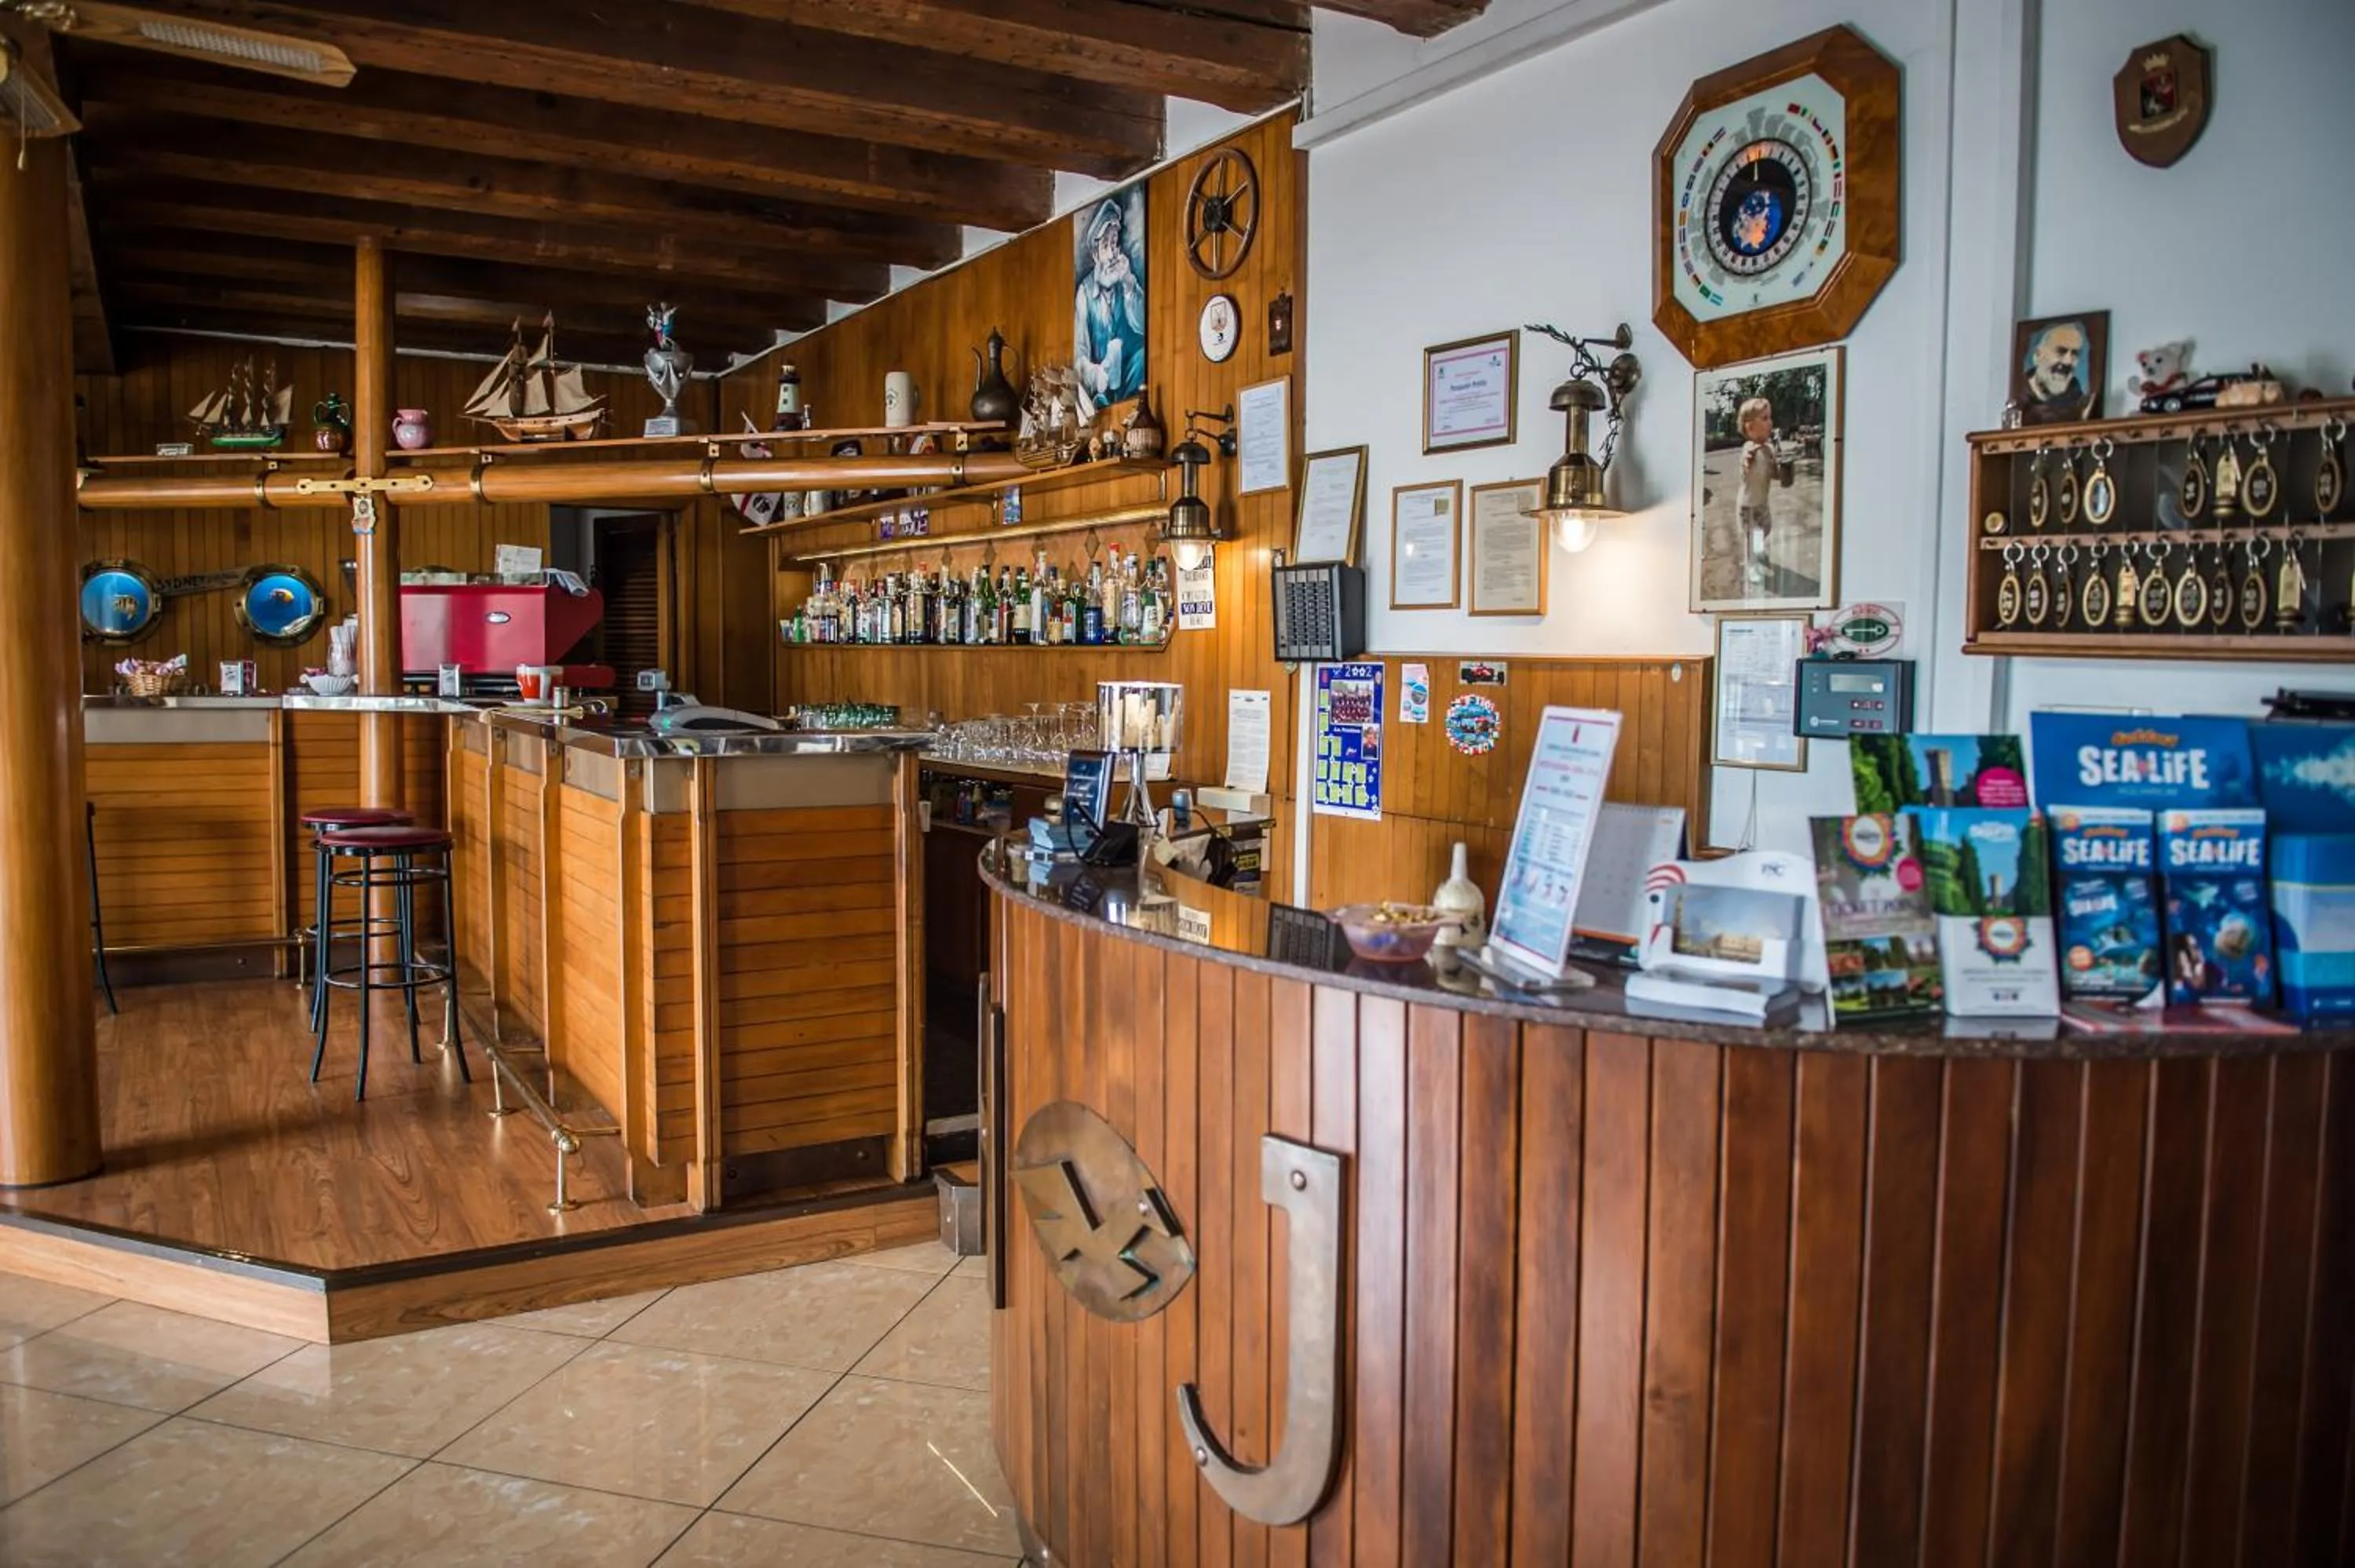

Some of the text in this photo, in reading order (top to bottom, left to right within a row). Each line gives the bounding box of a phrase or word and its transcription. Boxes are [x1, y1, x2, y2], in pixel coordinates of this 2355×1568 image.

[2078, 745, 2138, 786] SEA
[2062, 837, 2105, 865] SEA
[2169, 837, 2214, 866] SEA
